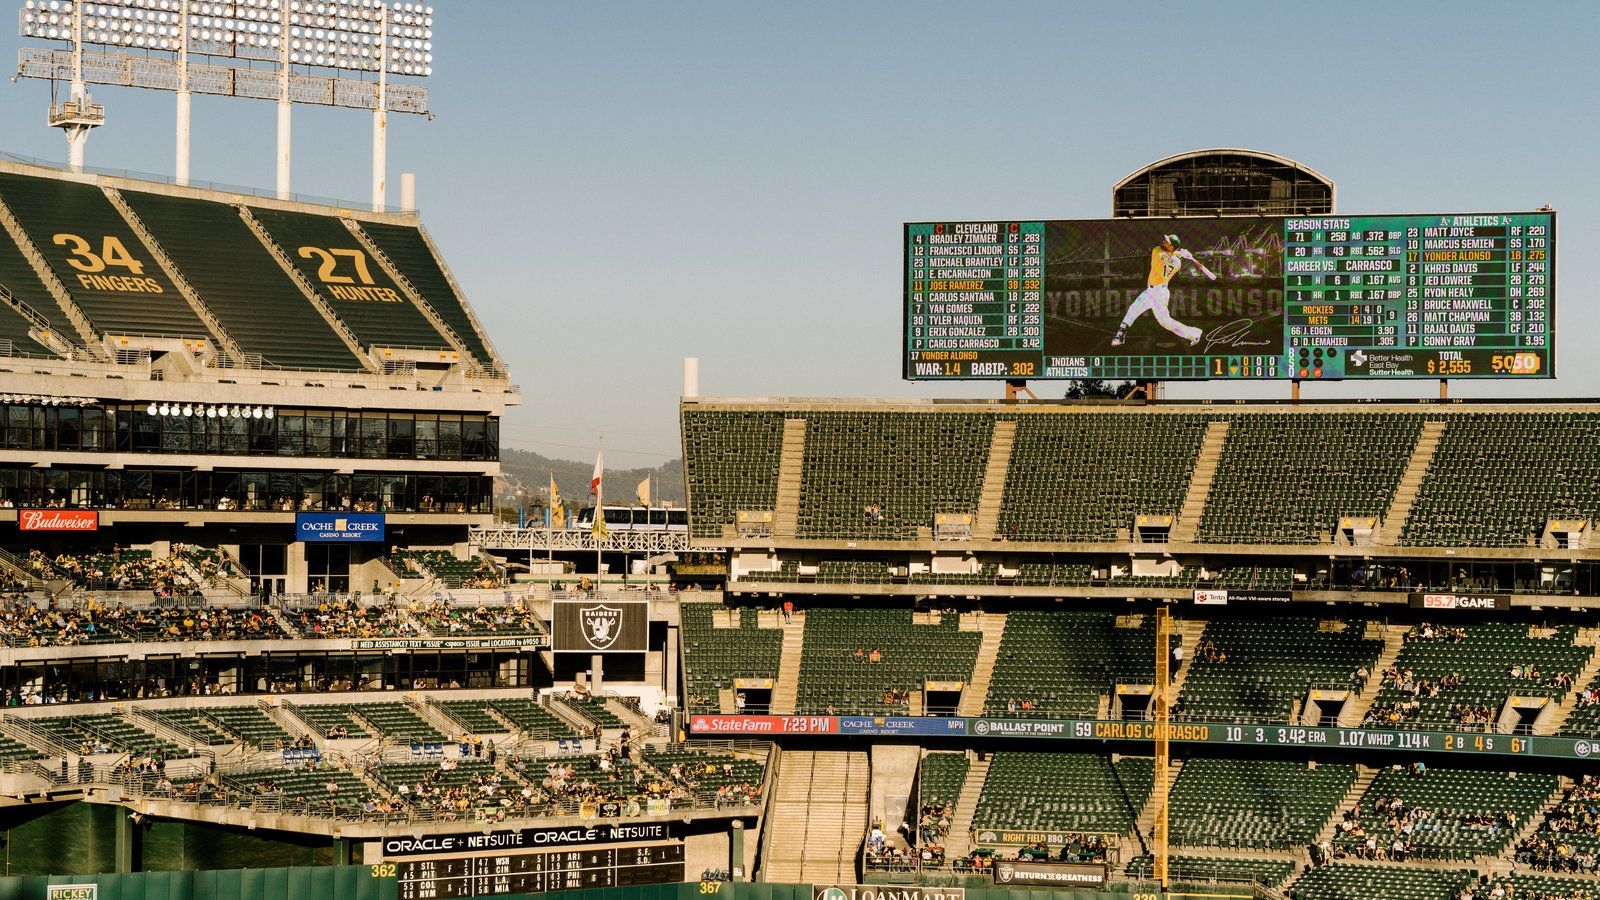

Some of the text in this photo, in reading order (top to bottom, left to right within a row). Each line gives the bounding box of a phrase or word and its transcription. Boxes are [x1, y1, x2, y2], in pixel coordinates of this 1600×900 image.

[1288, 220, 1350, 230] SEASON STATS
[1454, 216, 1498, 226] ATHLETICS
[956, 224, 998, 234] CLEVELAND
[1425, 228, 1474, 237] MATT JOYCE
[930, 235, 997, 244] BRADLEY ZIMMER
[1425, 239, 1494, 249] MARCUS SEMIEN
[53, 234, 144, 275] 34
[930, 246, 1002, 256] FRANCISCO LINDOR
[1425, 251, 1491, 261] YONDER ALONSO
[298, 247, 375, 284] 27
[930, 258, 1003, 267] MICHAEL BRANTLEY
[1288, 261, 1392, 271] CAREER VS. CARRASCO
[1425, 264, 1478, 273] KHRIS DAVIS
[938, 269, 991, 279] ENCARNACION
[77, 274, 164, 293] FINGERS
[1424, 276, 1473, 285] JED LOWRIE
[930, 281, 984, 291] JOSE RAMIREZ
[326, 285, 404, 303] HUNTER
[929, 292, 994, 302] CARLOS SANTANA
[1424, 288, 1474, 297] RYON HEALY
[1172, 289, 1282, 317] ALONSO
[1424, 300, 1493, 310] BRUCE MAXWELL
[929, 304, 973, 313] YAN GOMES
[1303, 306, 1334, 314] ROCKIES
[929, 316, 983, 326] TYLER NAQUIN
[1309, 317, 1328, 325] METS
[1424, 312, 1490, 322] MATT CHAPMAN
[929, 327, 986, 336] ERIK GONZALEZ
[1310, 326, 1332, 335] EDGIN
[1424, 324, 1475, 334] RAJAI DAVIS
[929, 339, 1040, 348] CARLOS CARRASCO 3.42
[1312, 338, 1348, 346] LEMAHIEU
[1424, 336, 1544, 346] SONNY GRAY 3.95
[911, 352, 978, 360] 17 YONDER ALONSO
[1439, 351, 1463, 360] TOTAL
[1052, 358, 1085, 367] INDIANS
[1386, 362, 1399, 370] Bay
[916, 363, 1034, 376] WAR: 1.4 BABIP: .302
[1047, 368, 1088, 377] ATHLETICS
[1440, 361, 1471, 375] 2,555
[23, 512, 94, 529] Budweiser
[348, 523, 379, 531] CREEK
[1426, 596, 1454, 607] 95.7
[1460, 597, 1495, 608] GAME
[409, 640, 422, 648] TEXT
[782, 718, 807, 732] 7:23
[811, 718, 829, 731] PM
[948, 721, 964, 729] MPH
[991, 723, 1064, 733] BALLAST POINT
[1076, 723, 1092, 737] 59
[1096, 723, 1142, 738] CARLOS
[1227, 727, 1241, 741] 10
[1278, 729, 1306, 744] 3.42
[1309, 732, 1326, 743] ERA
[1339, 731, 1365, 746] 1.07
[1368, 734, 1394, 746] WHIP
[1398, 733, 1421, 748] 114
[1423, 736, 1429, 747] K
[1445, 737, 1453, 750] 2
[1458, 738, 1464, 749] B
[1475, 737, 1484, 751] 4
[1486, 738, 1493, 750] S
[387, 826, 661, 852] ORACLE NETSUITE ORACLE NETSUITE
[1003, 834, 1025, 842] RIGHT
[1027, 834, 1046, 843] FIELD
[1048, 835, 1063, 843] BBQ
[568, 853, 580, 861] ARI
[372, 865, 396, 877] 362
[421, 863, 435, 871] STL
[496, 866, 508, 874] CIN
[422, 871, 435, 879] PIT
[1015, 871, 1045, 880] RETURN
[1056, 873, 1102, 882] GREATNESS
[495, 885, 510, 893] MIA
[567, 880, 580, 888] MIL
[700, 882, 721, 894] 367
[53, 889, 91, 899] RICKEY
[420, 890, 436, 898] NYM
